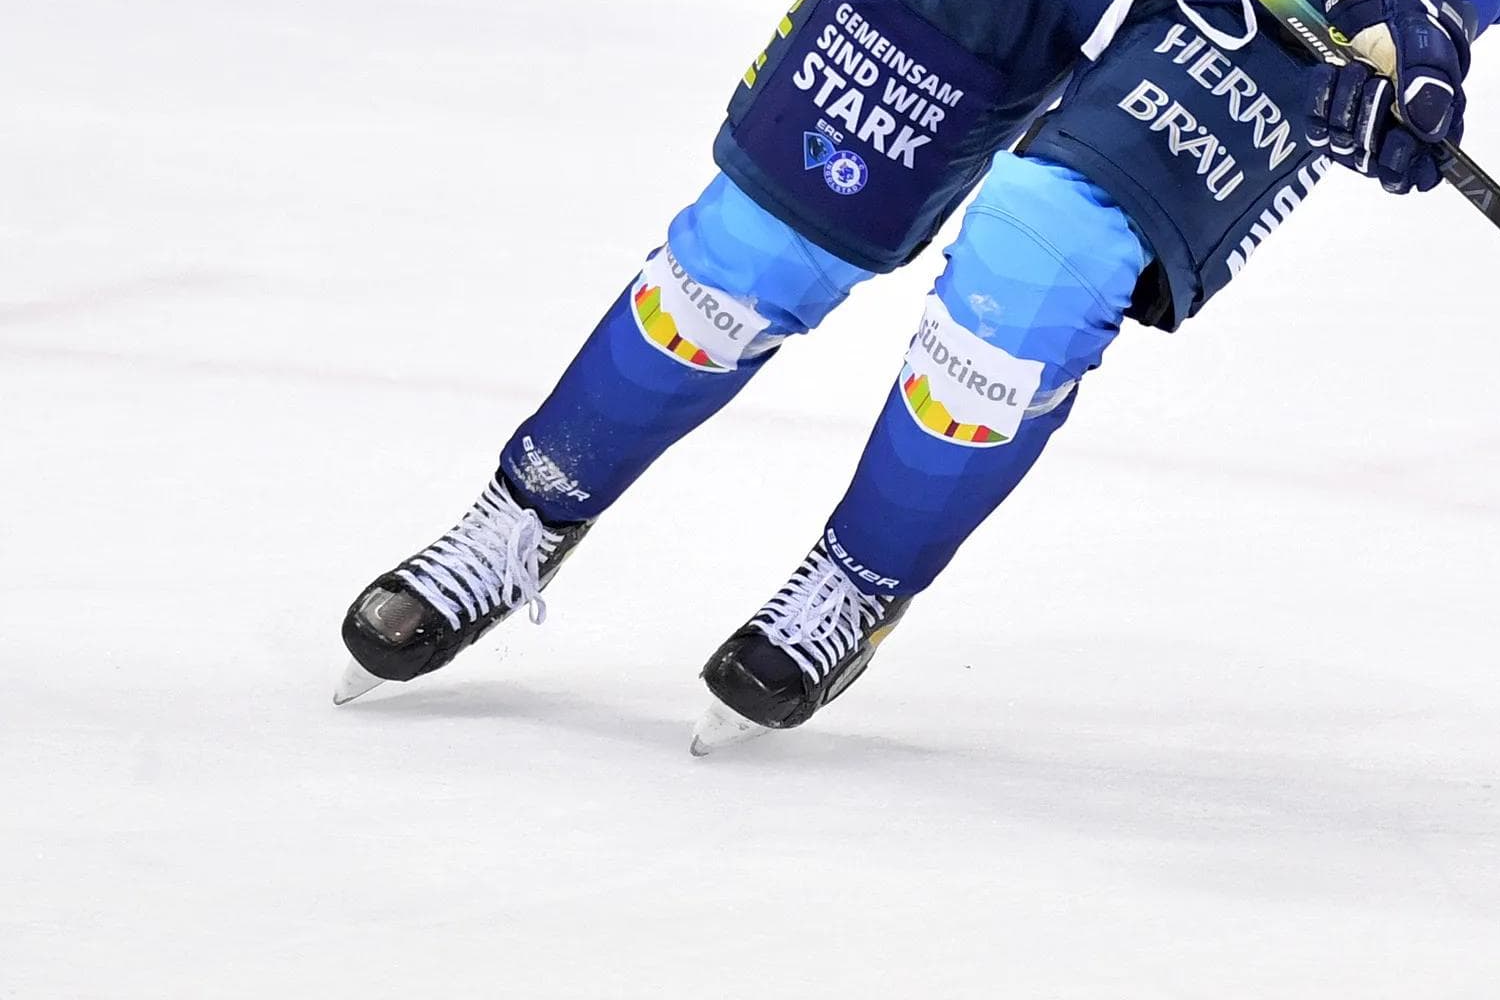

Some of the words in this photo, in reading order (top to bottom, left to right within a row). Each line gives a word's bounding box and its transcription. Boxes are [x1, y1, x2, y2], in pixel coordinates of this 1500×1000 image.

[792, 51, 933, 170] STARK
[816, 23, 880, 88] SIND
[882, 76, 946, 134] WIR
[834, 2, 965, 108] GEMEINSAM
[1153, 23, 1297, 172] HERRN
[815, 118, 845, 144] ERC
[1117, 78, 1245, 202] BRÄU
[826, 527, 900, 589] BAUER
